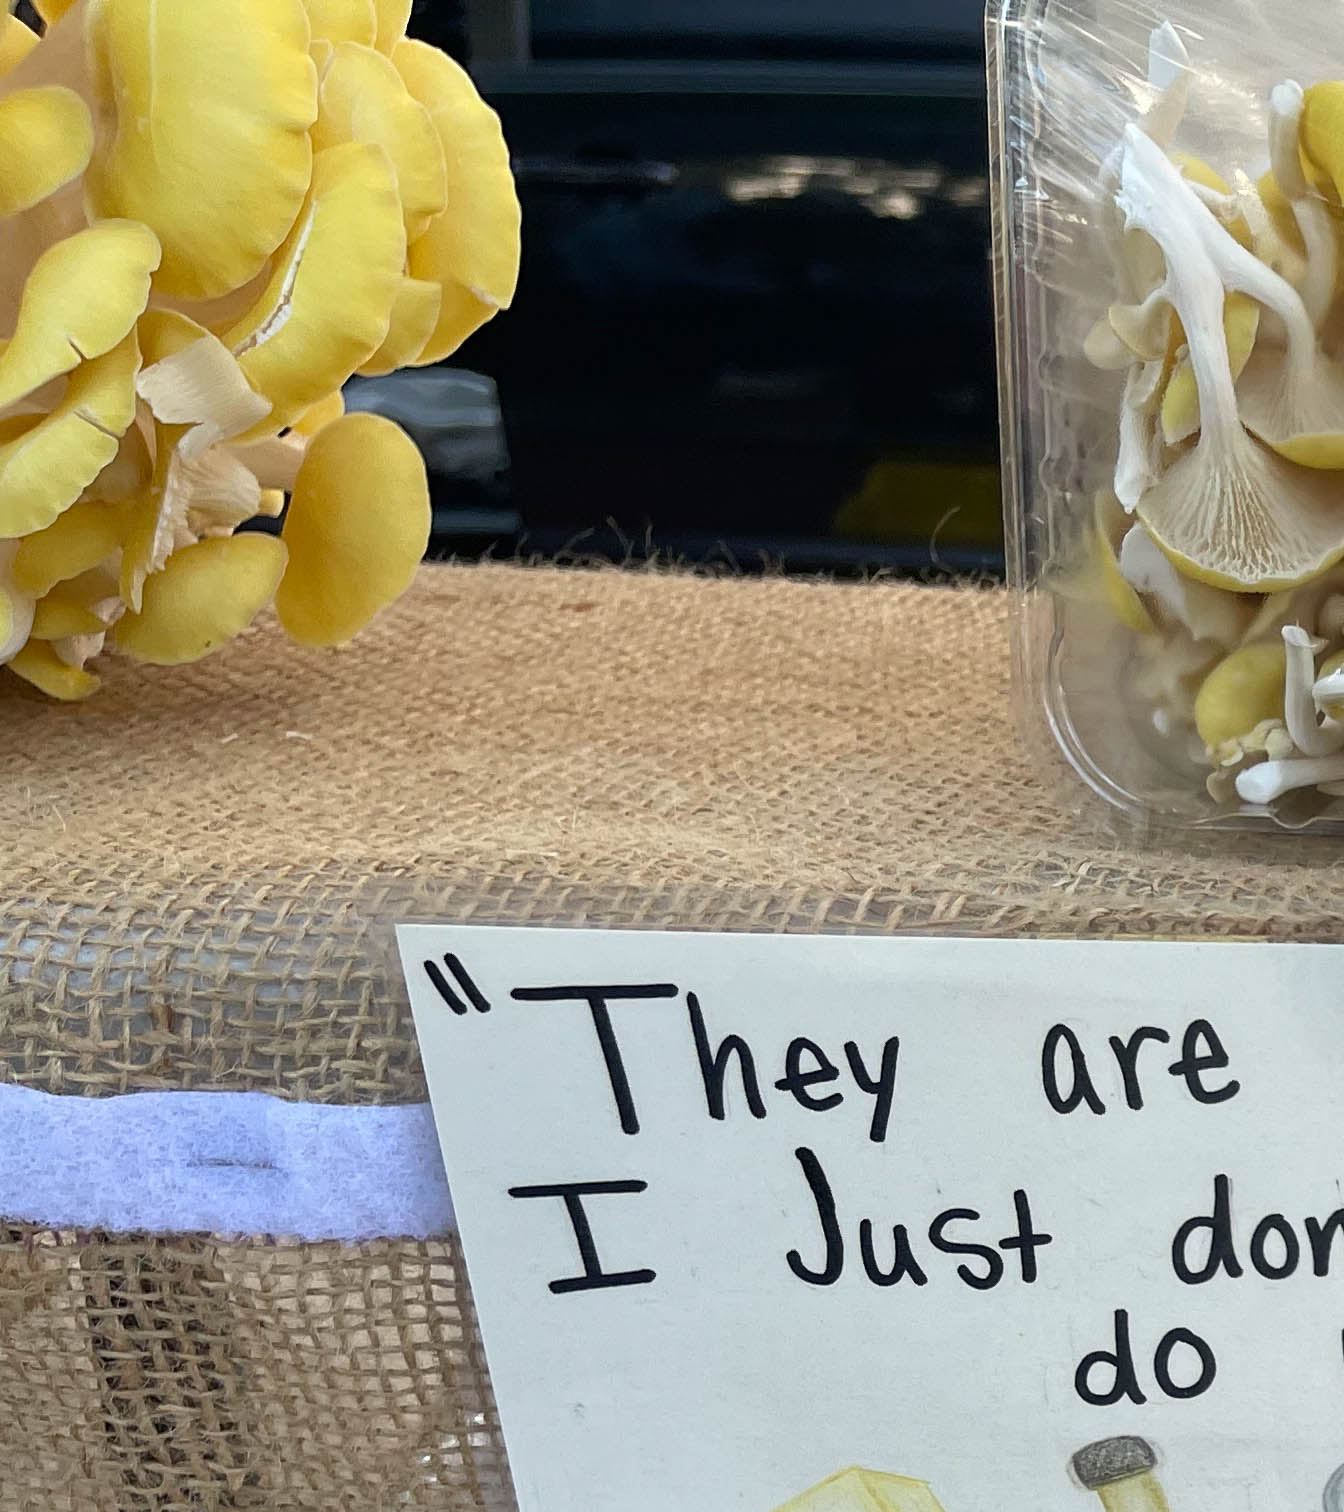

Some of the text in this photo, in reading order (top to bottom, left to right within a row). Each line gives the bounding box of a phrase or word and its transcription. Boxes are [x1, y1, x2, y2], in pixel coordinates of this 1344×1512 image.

[1041, 1018, 1241, 1116] are
[507, 1179, 657, 1295] I
[785, 1146, 1053, 1291] Just
[1074, 1308, 1217, 1407] do
